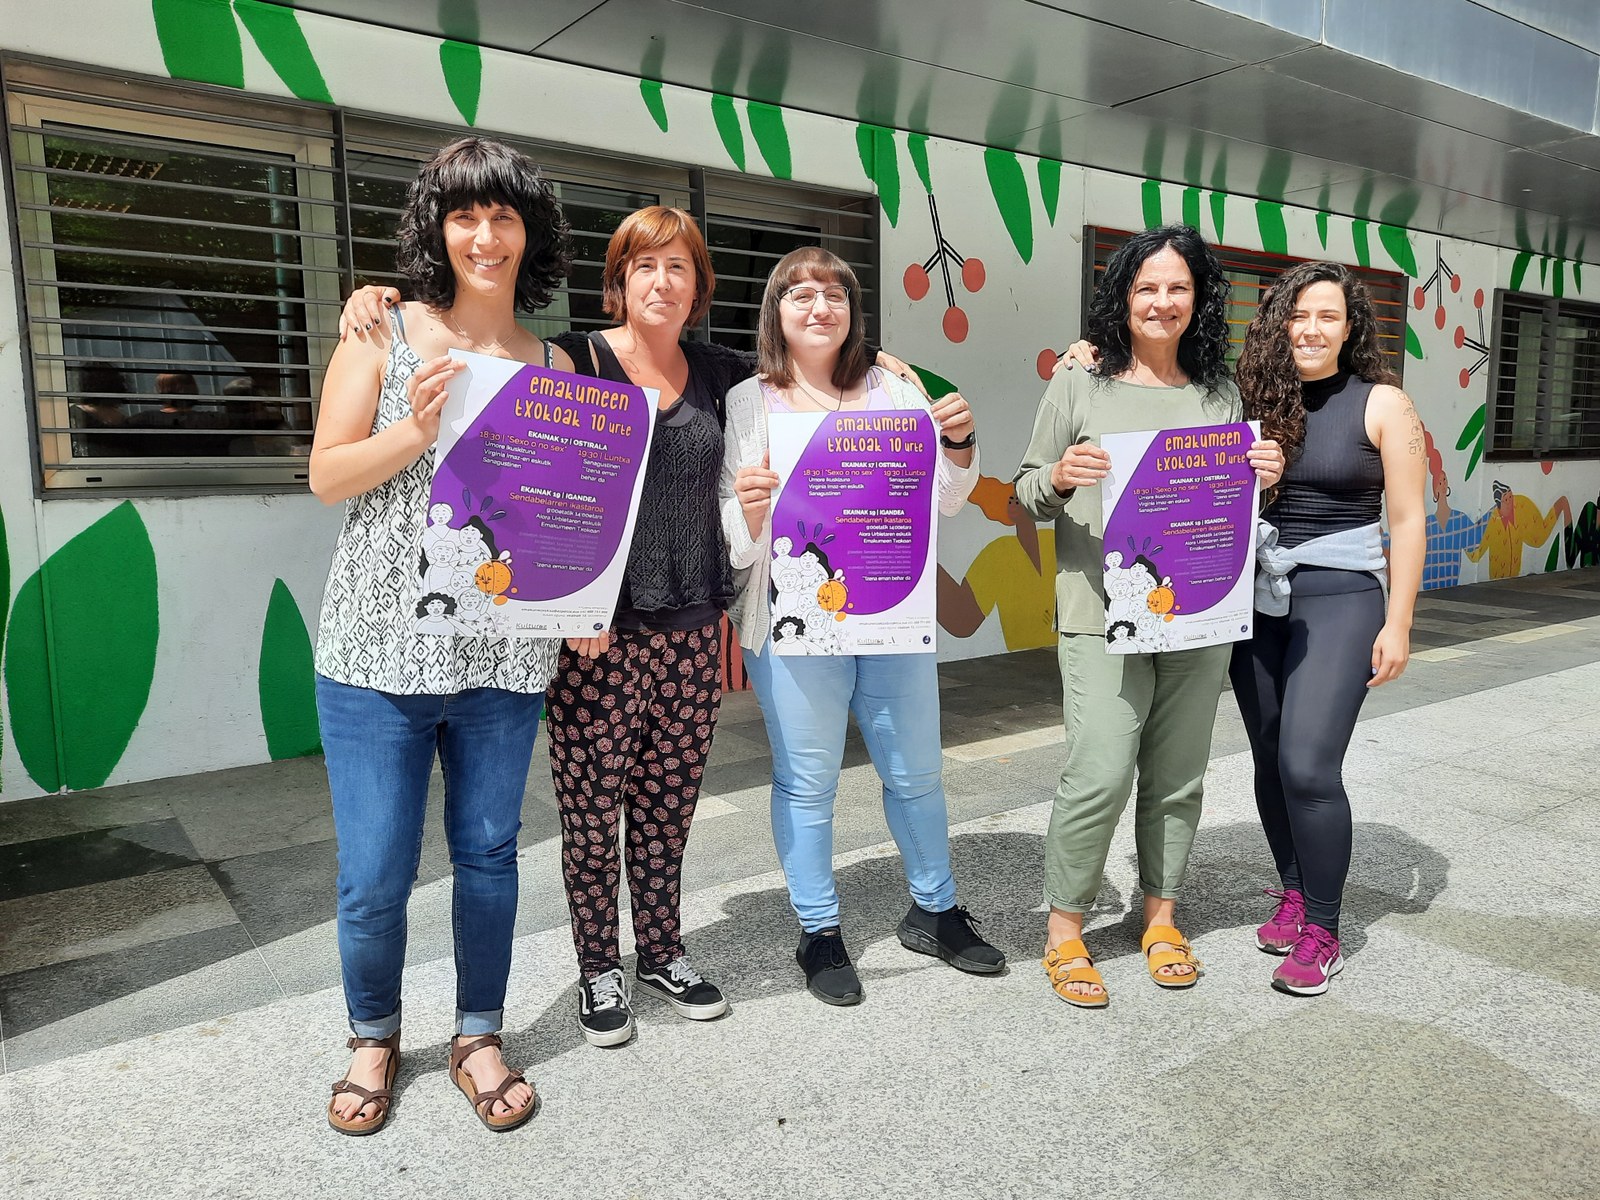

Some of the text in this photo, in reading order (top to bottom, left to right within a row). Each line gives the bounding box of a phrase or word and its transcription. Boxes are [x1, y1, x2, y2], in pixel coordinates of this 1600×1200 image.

[530, 376, 629, 411] emakumeen
[515, 398, 632, 436] txokoak 10 urte
[836, 416, 917, 432] emakumeen
[528, 430, 559, 442] EKAINAK
[560, 437, 568, 445] 17
[573, 439, 608, 450] OSTIRALA
[827, 437, 923, 452] txokoak 10 urte
[1166, 431, 1240, 451] emakumeen
[485, 441, 536, 455] Umore ikuskizuna
[482, 457, 522, 468] Sanagustinen
[483, 449, 552, 466] Virginia Imaz-en eskutik
[583, 458, 621, 469] Sanagustinen
[604, 453, 631, 463] Luntxa
[1157, 452, 1246, 471] txokoak 10 urte
[1169, 477, 1194, 485] EKAINAK
[1204, 474, 1230, 482] OSTIRALA
[520, 485, 551, 496] EKAINAK
[565, 493, 597, 503] IGANDEA
[509, 491, 604, 513] Sendabelarren ikastaroa
[541, 521, 600, 534] Emakumeen Txokoan
[582, 519, 601, 527] eskutik
[1170, 520, 1194, 528] EKAINAK
[1204, 517, 1228, 525] IGANDEA
